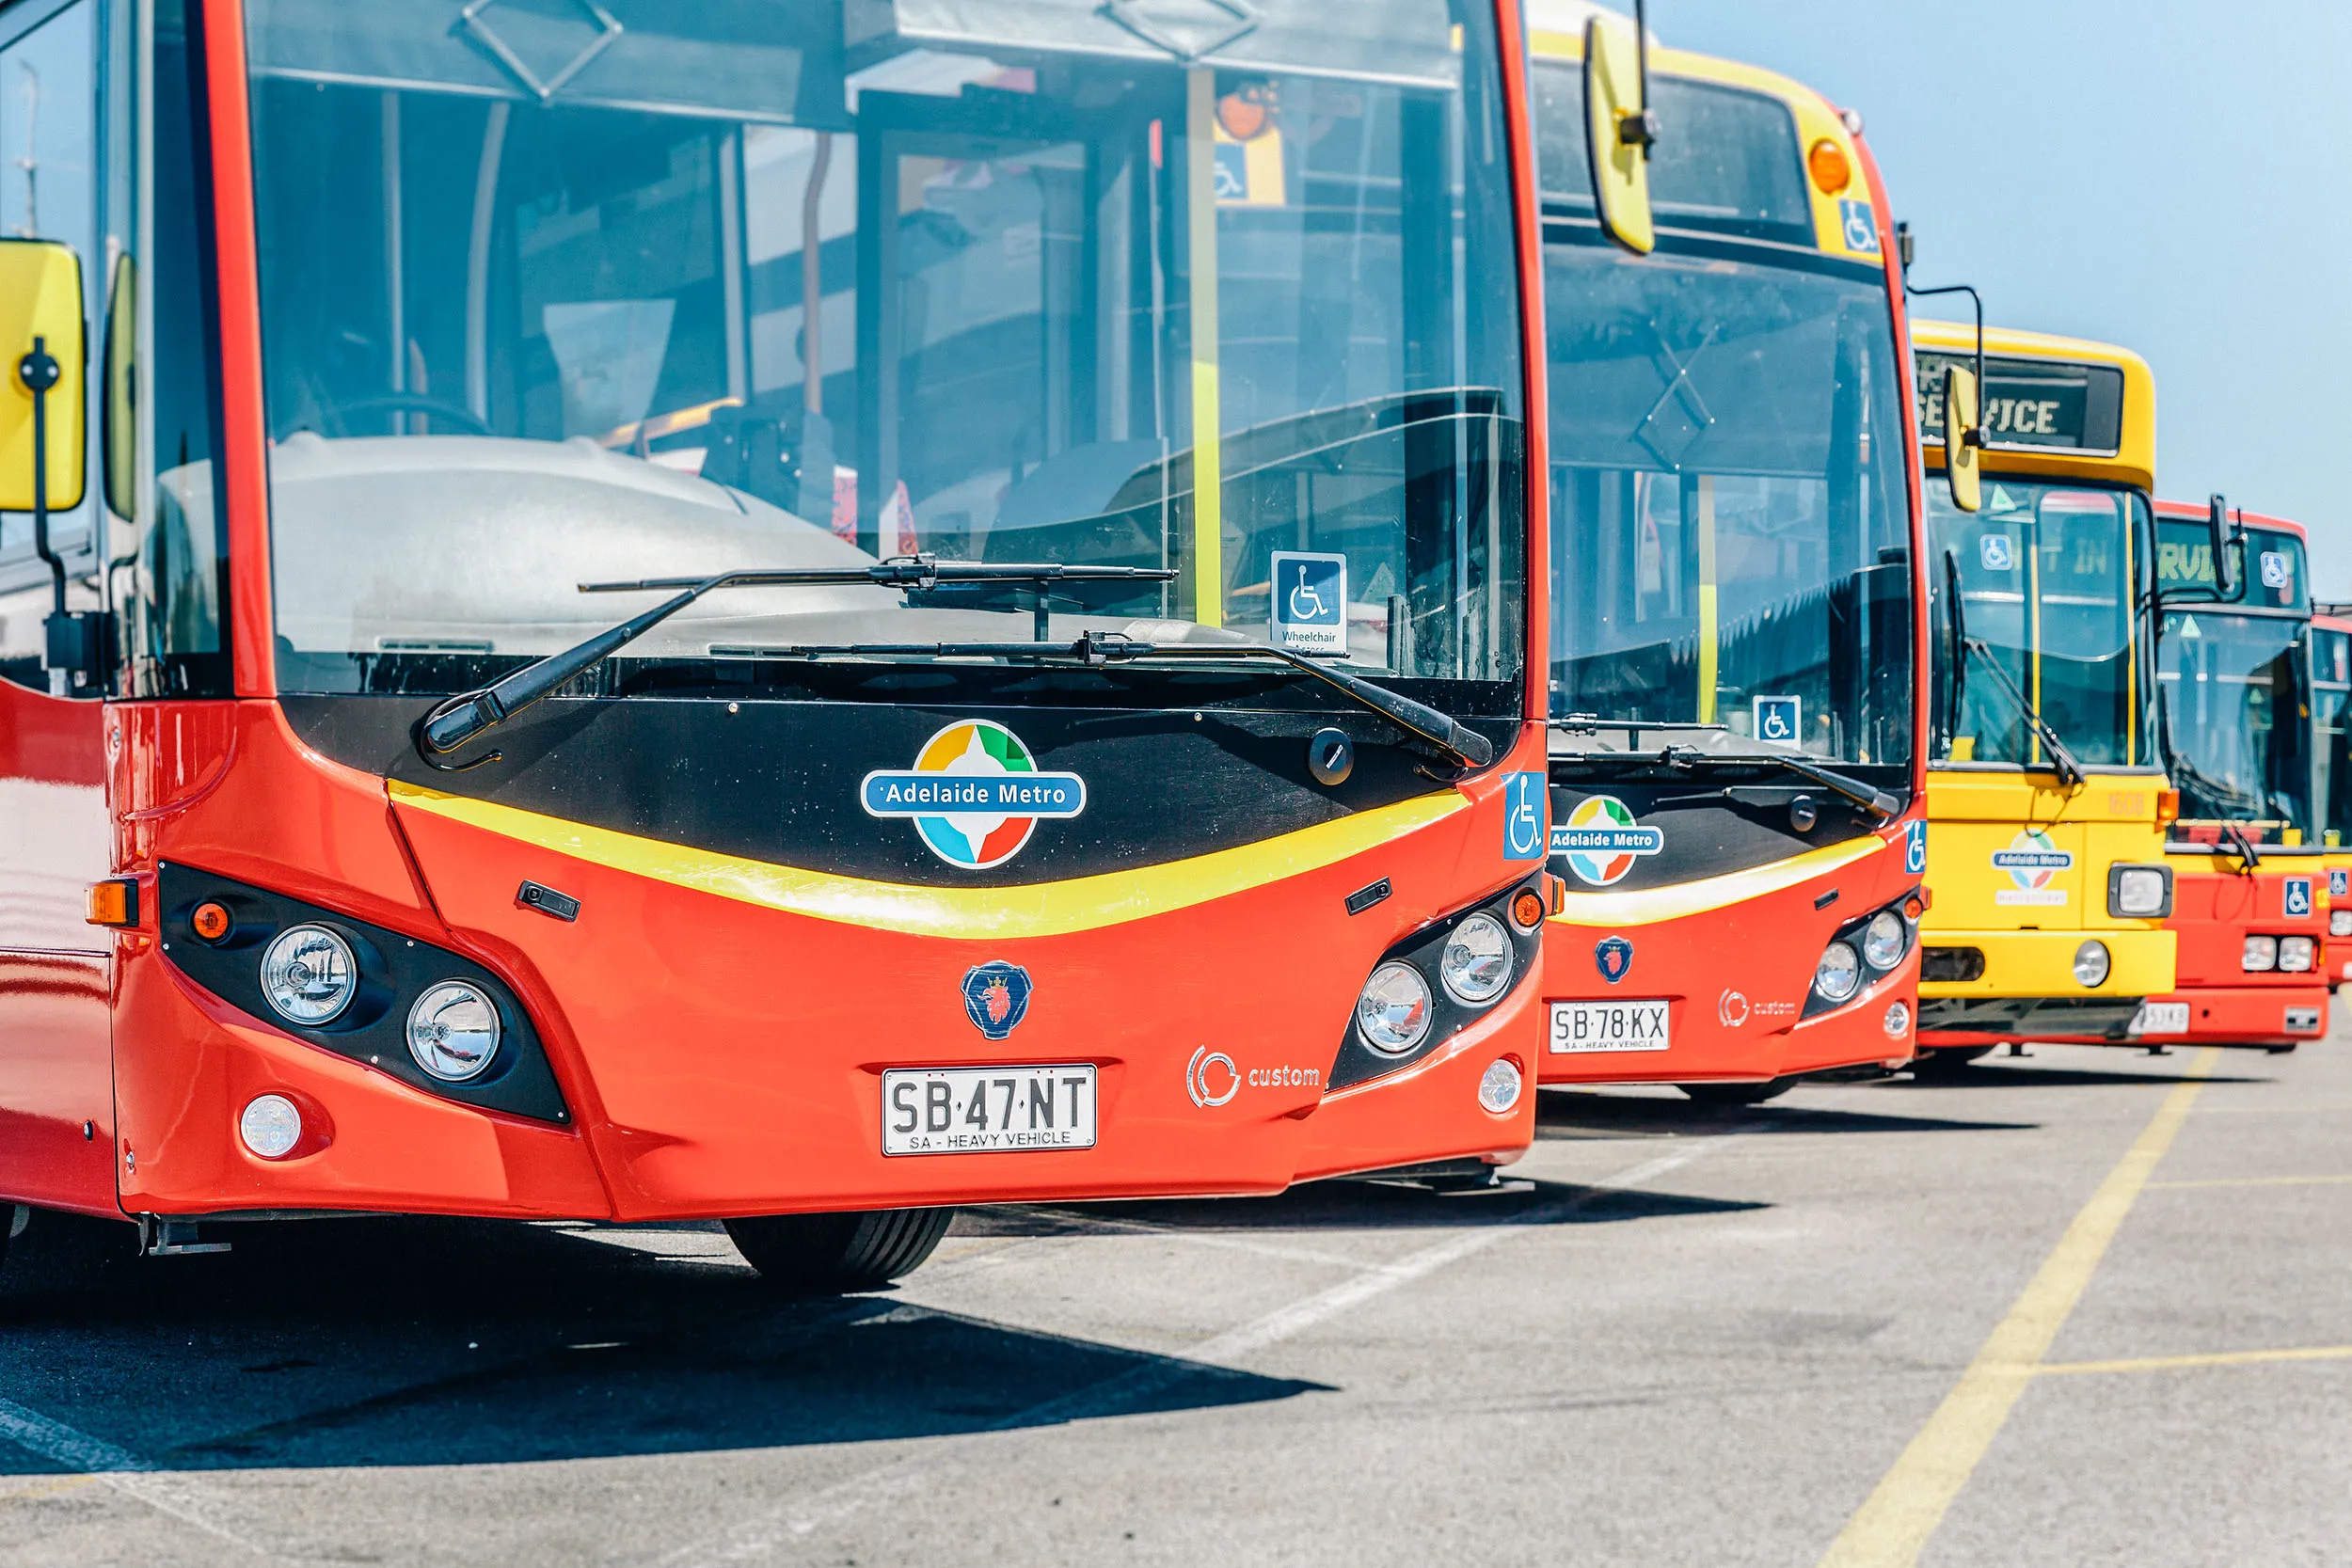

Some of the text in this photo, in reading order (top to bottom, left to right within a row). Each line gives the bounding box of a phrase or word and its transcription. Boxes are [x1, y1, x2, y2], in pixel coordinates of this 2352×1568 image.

[1918, 393, 2060, 434] EVICE
[1281, 631, 1337, 642] Wheelchair
[885, 783, 1066, 804] Adelaide Metro
[1550, 832, 1653, 847] Adelaide Metro
[1753, 1001, 1795, 1015] custom
[1586, 1041, 1615, 1050] HEAVY
[1618, 1039, 1655, 1049] VEHICLE
[1248, 1064, 1320, 1087] custom
[910, 1136, 931, 1149] SA
[946, 1132, 1001, 1148] HEAVY
[1006, 1131, 1071, 1146] VEHICLE
